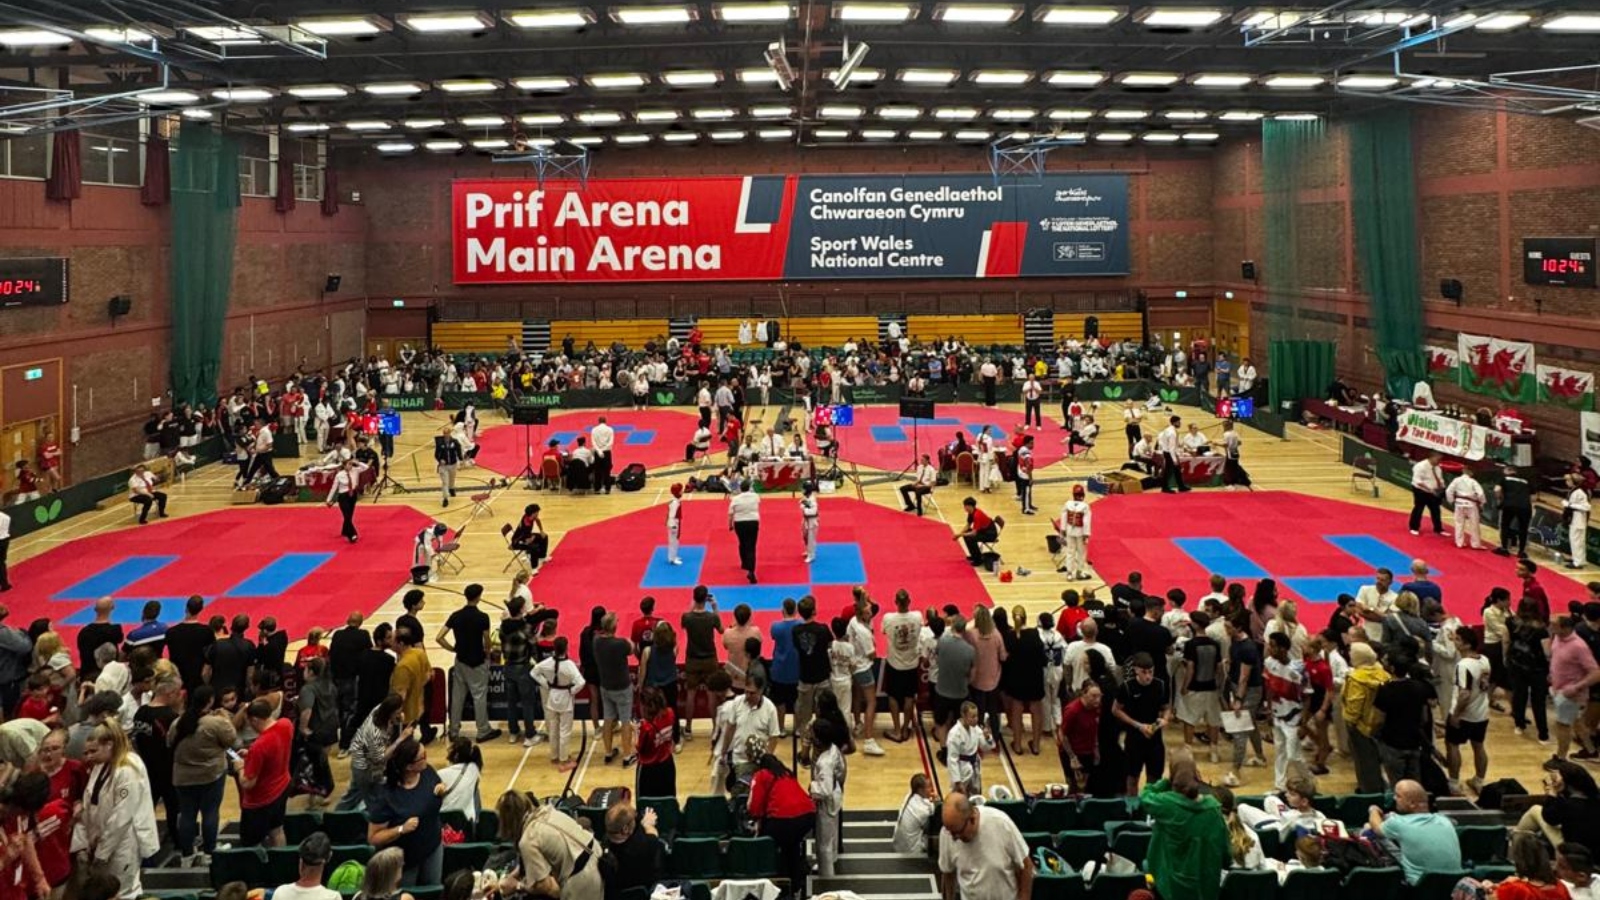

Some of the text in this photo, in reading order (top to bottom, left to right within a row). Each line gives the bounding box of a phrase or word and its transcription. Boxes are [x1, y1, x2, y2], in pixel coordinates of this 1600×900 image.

[809, 185, 1003, 204] Canolfan Genedlaethol
[466, 191, 689, 229] Prif Arena
[809, 204, 965, 221] Chwaraeon Cymru
[466, 236, 721, 273] Main Arena
[810, 235, 914, 257] Sport Wales
[810, 252, 944, 268] National Centre
[1407, 413, 1439, 431] Wales
[1412, 427, 1458, 448] Tae Kwon Do
